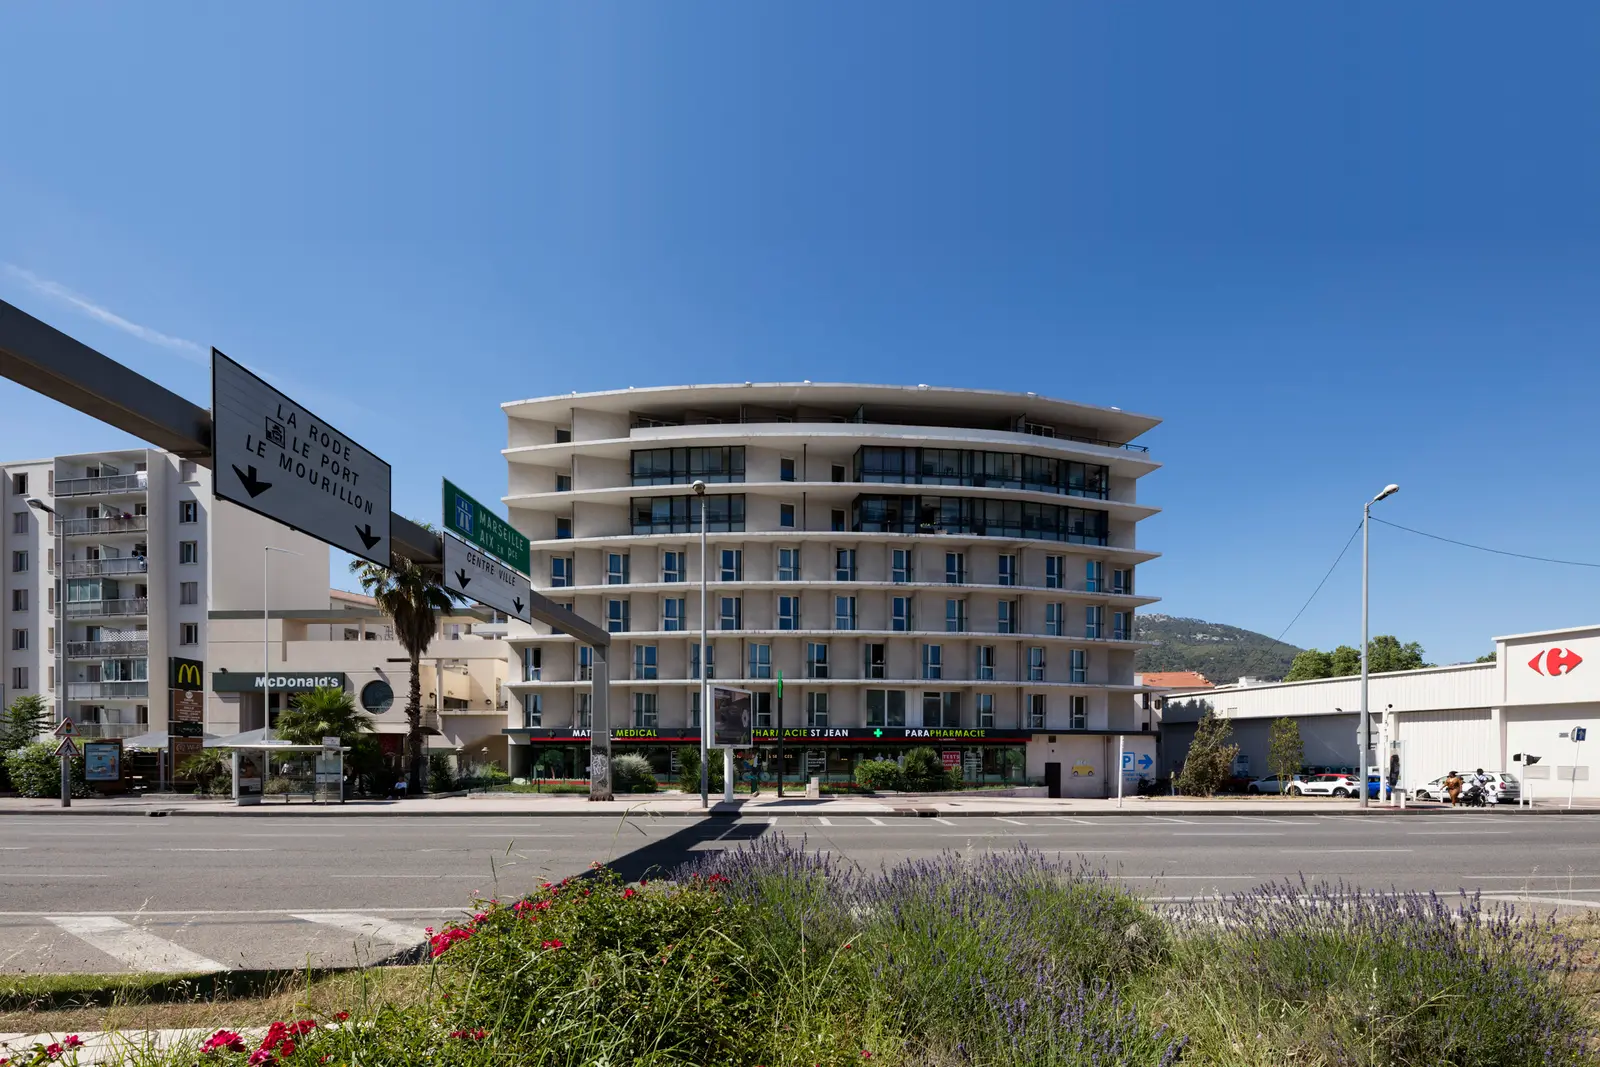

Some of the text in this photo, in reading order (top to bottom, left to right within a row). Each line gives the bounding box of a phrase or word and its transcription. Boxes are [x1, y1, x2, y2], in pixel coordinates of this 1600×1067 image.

[277, 404, 351, 462] LA RODE
[292, 436, 359, 486] LE PORT
[246, 434, 373, 515] LE MOURILLON
[480, 512, 524, 551] MARSEILLE
[480, 529, 494, 549] AIX
[467, 552, 516, 587] CENTRE VILLE
[254, 676, 339, 688] McDonald's
[572, 729, 658, 738] MATL MEDICAL
[810, 728, 821, 737] ST
[823, 728, 849, 737] JEAN
[905, 729, 986, 738] PARAPHARMACIE
[1122, 755, 1132, 769] P
